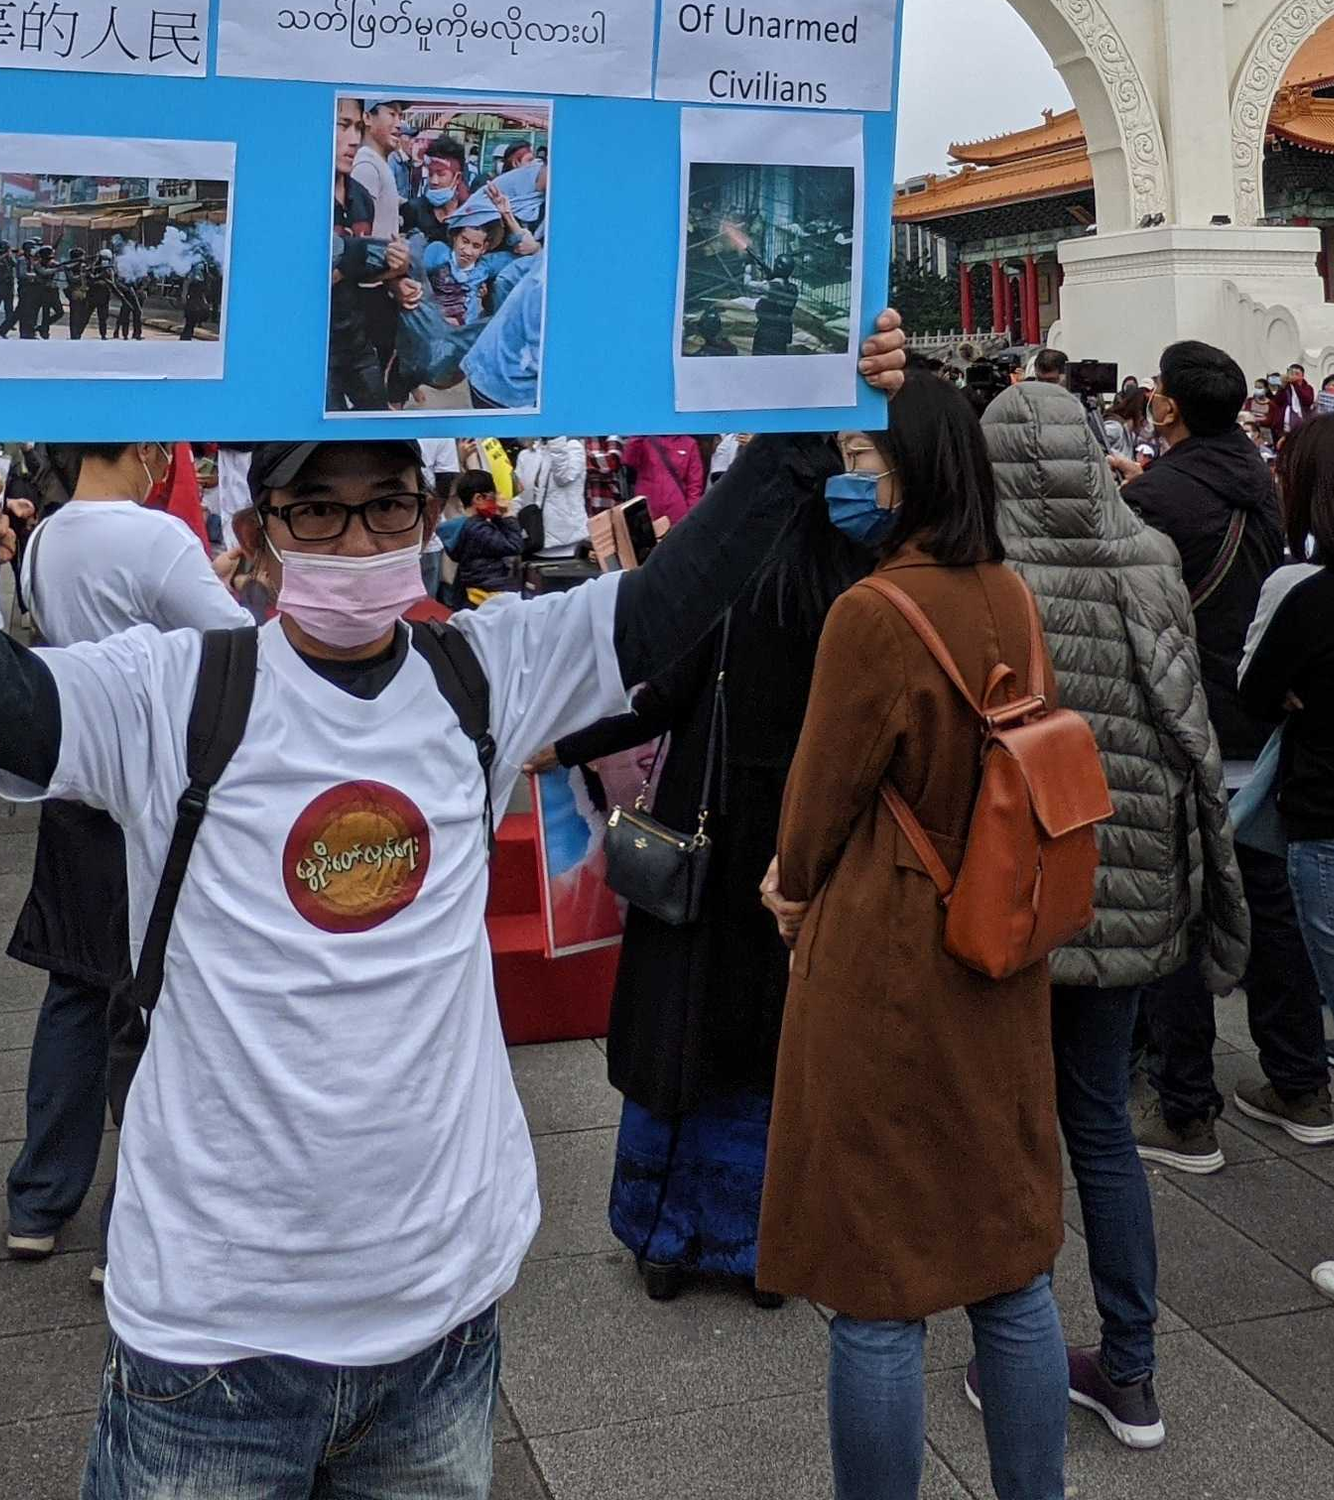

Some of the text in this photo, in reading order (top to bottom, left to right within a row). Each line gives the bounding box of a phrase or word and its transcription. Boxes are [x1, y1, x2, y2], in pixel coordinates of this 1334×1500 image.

[679, 4, 858, 44] Of Unarmed
[709, 69, 827, 104] Civilians
